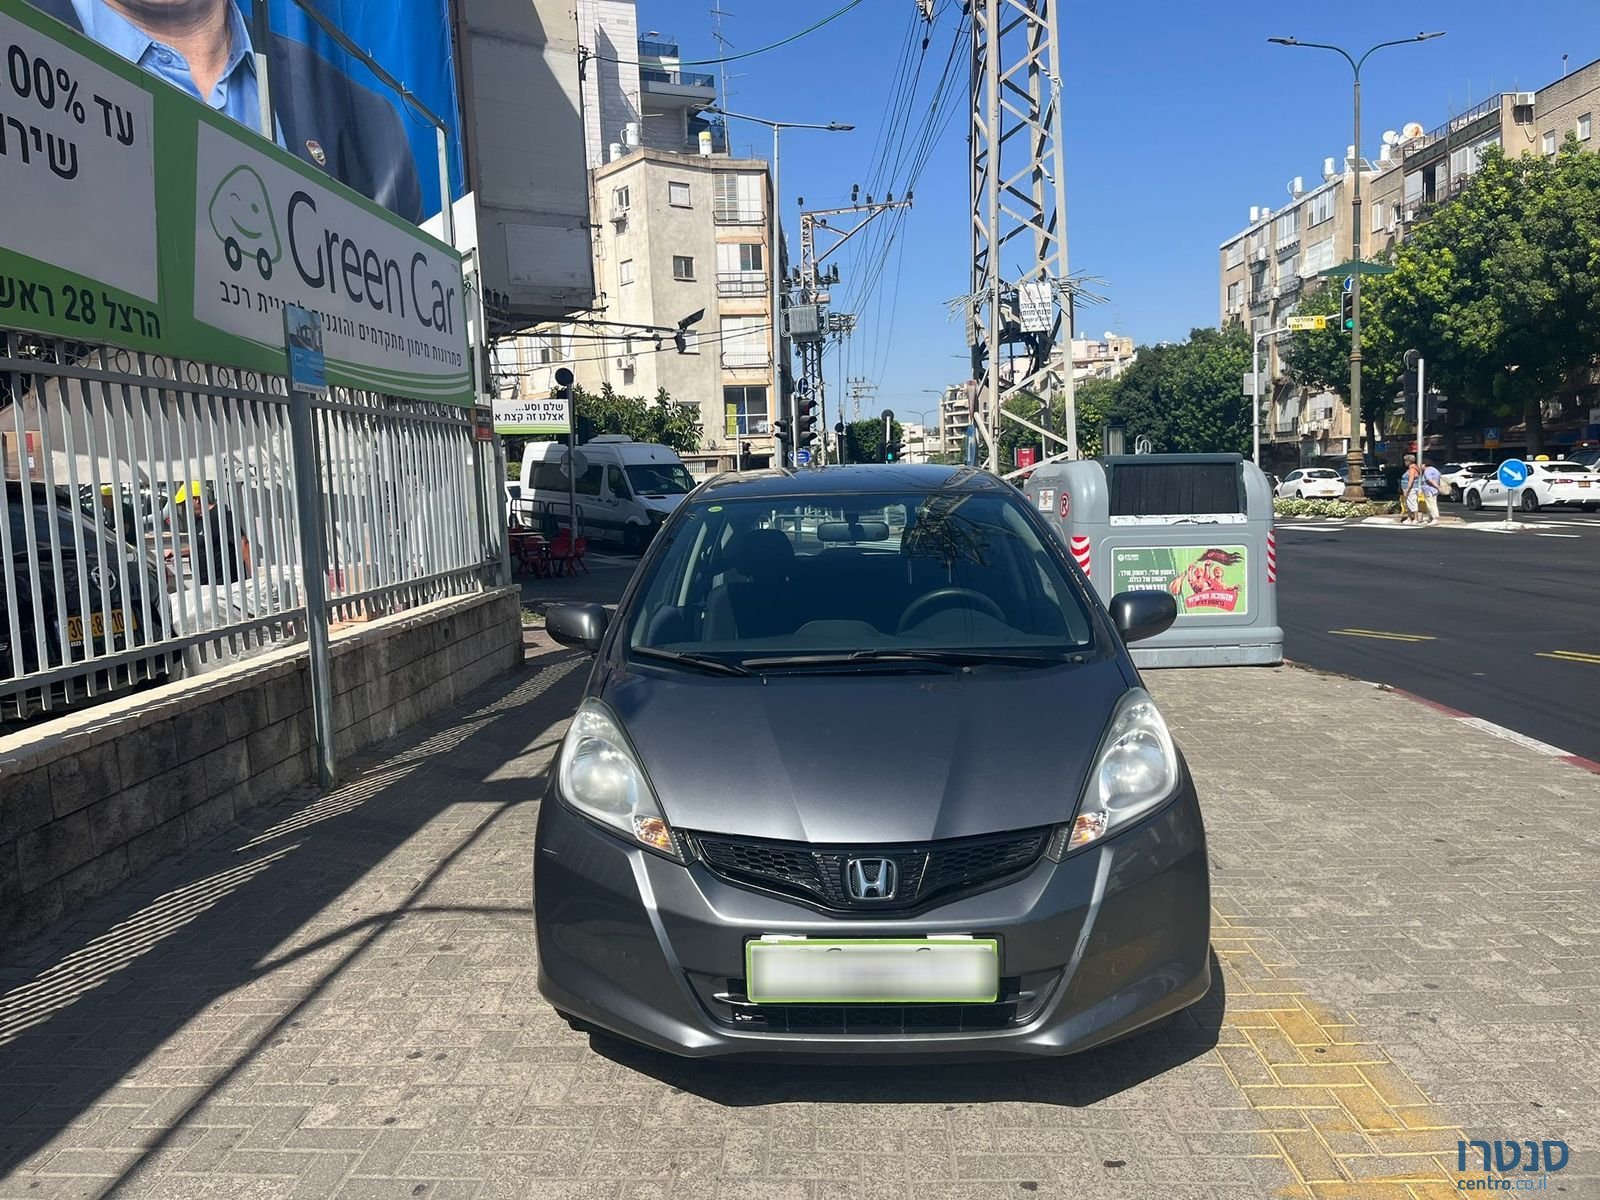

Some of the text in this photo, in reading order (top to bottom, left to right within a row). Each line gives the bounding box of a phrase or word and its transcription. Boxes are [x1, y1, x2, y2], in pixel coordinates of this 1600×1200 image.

[0, 44, 134, 146] עד 00%
[287, 190, 455, 335] Green Car
[62, 285, 96, 325] 28
[220, 280, 251, 309] רכב
[102, 292, 161, 339] הרצל
[312, 310, 354, 337] והוגני
[358, 323, 405, 352] מתקדמים
[407, 338, 430, 358] מימון
[432, 345, 462, 367] פתרונות
[504, 413, 523, 423] קצת
[515, 402, 564, 411] שלם וסע...
[526, 413, 536, 421] זה
[539, 411, 564, 421] אצלנו
